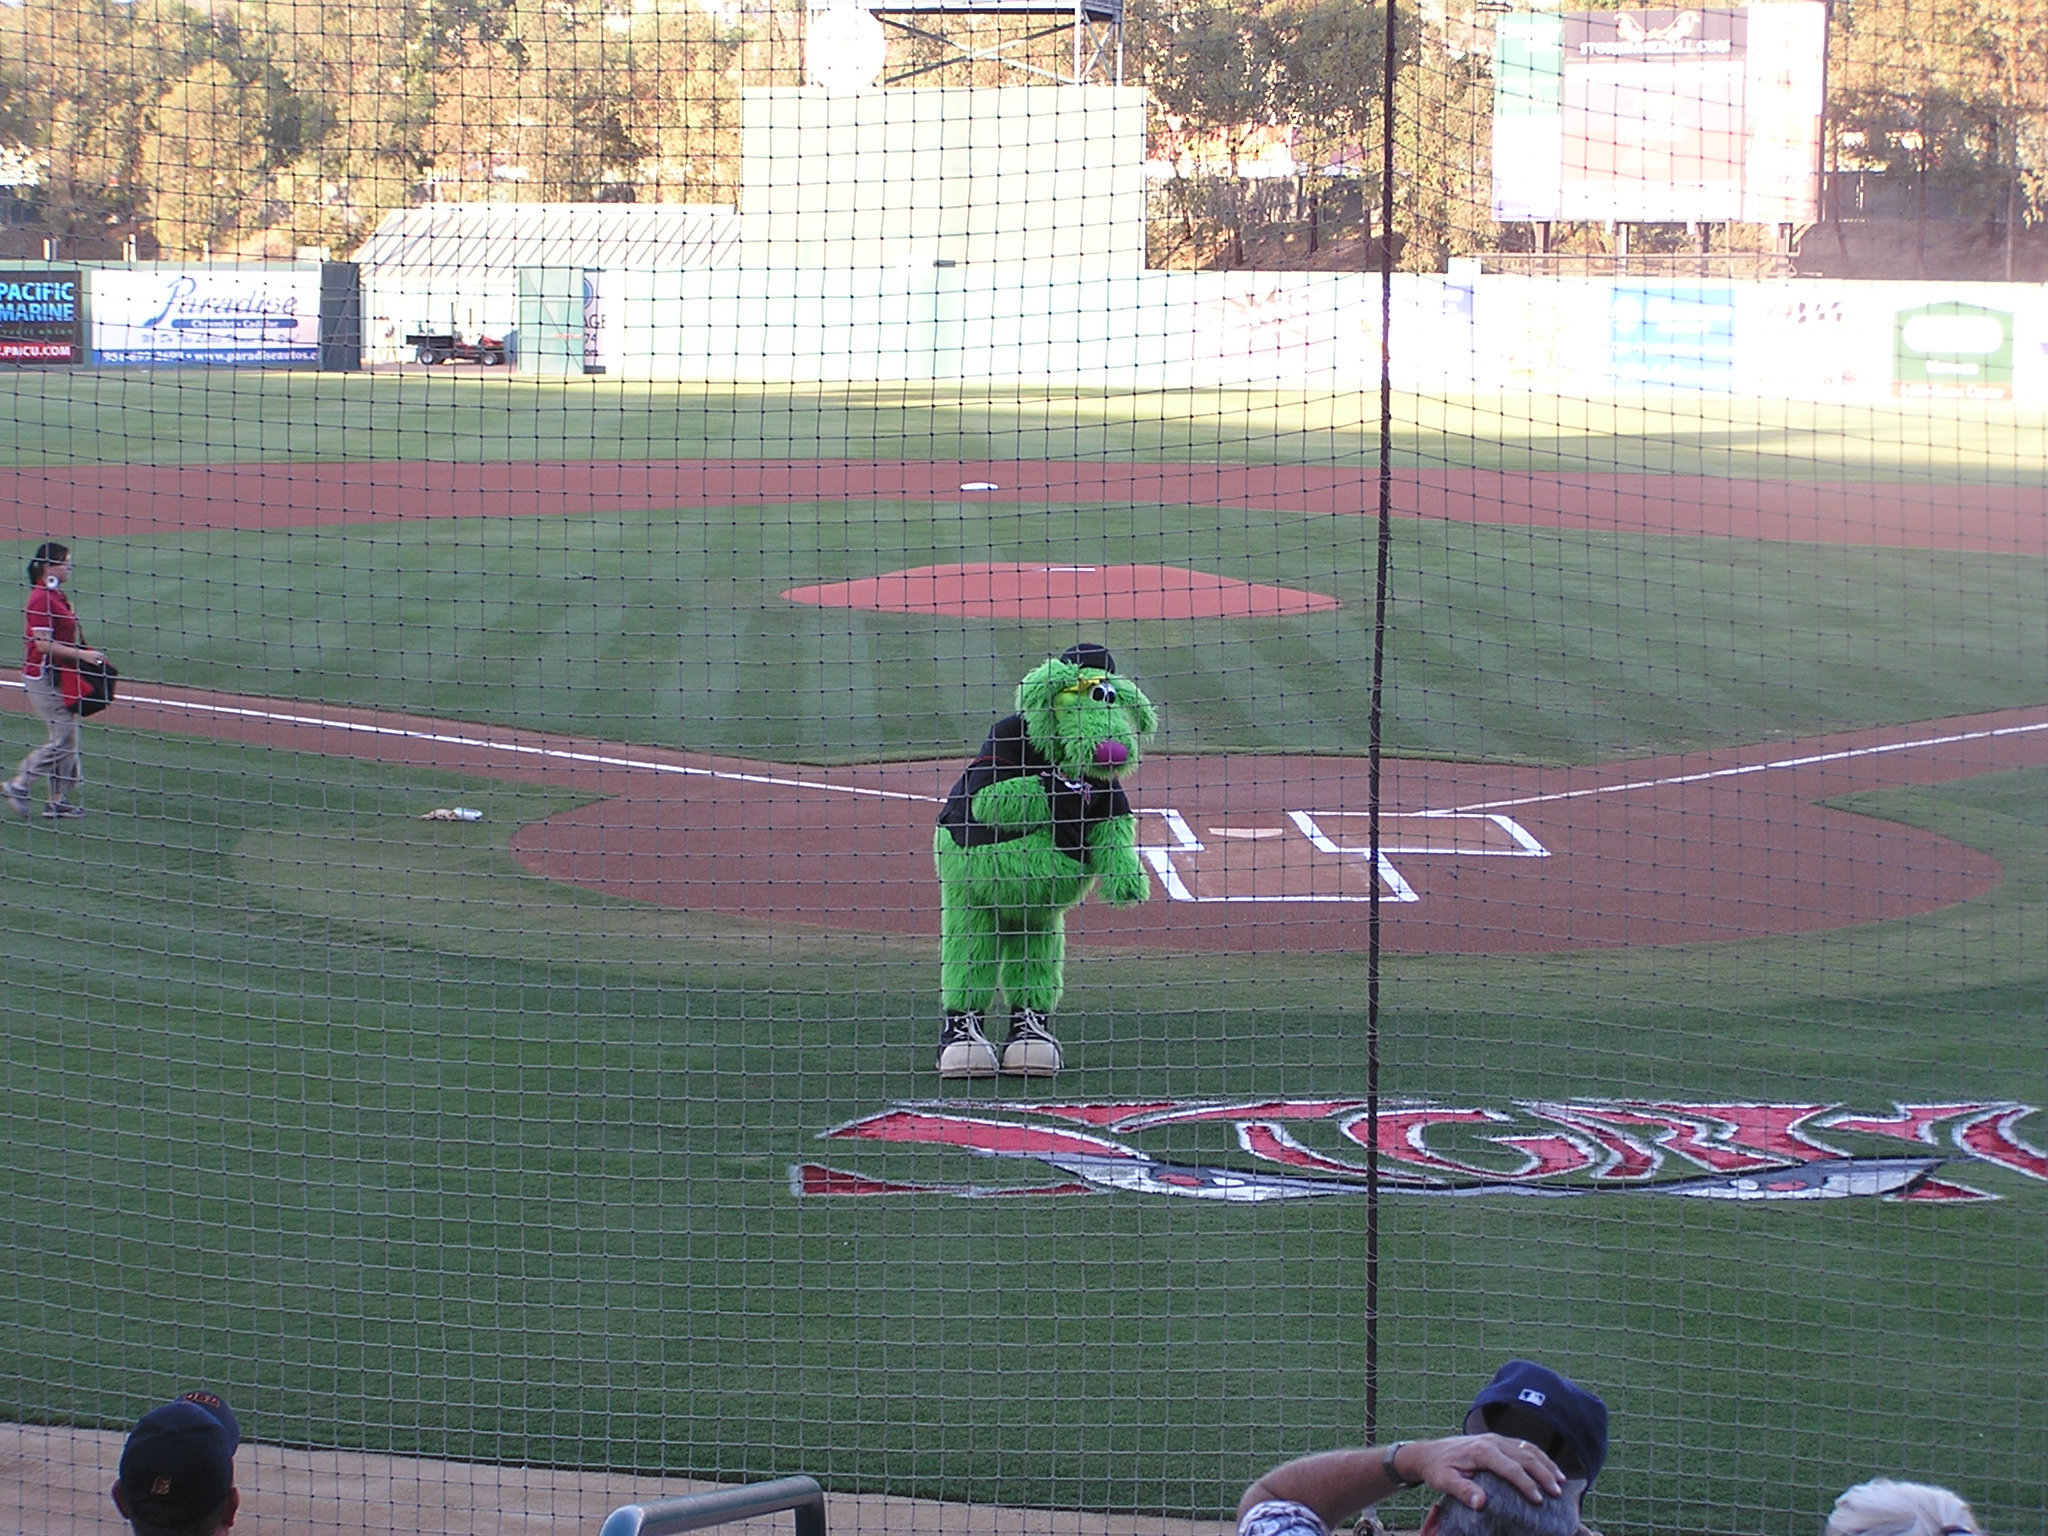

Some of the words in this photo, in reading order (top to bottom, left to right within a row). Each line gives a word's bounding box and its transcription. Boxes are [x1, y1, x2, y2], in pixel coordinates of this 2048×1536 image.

[0, 282, 75, 301] PACIFIC
[144, 276, 299, 326] Paradise
[0, 303, 75, 322] MARINE
